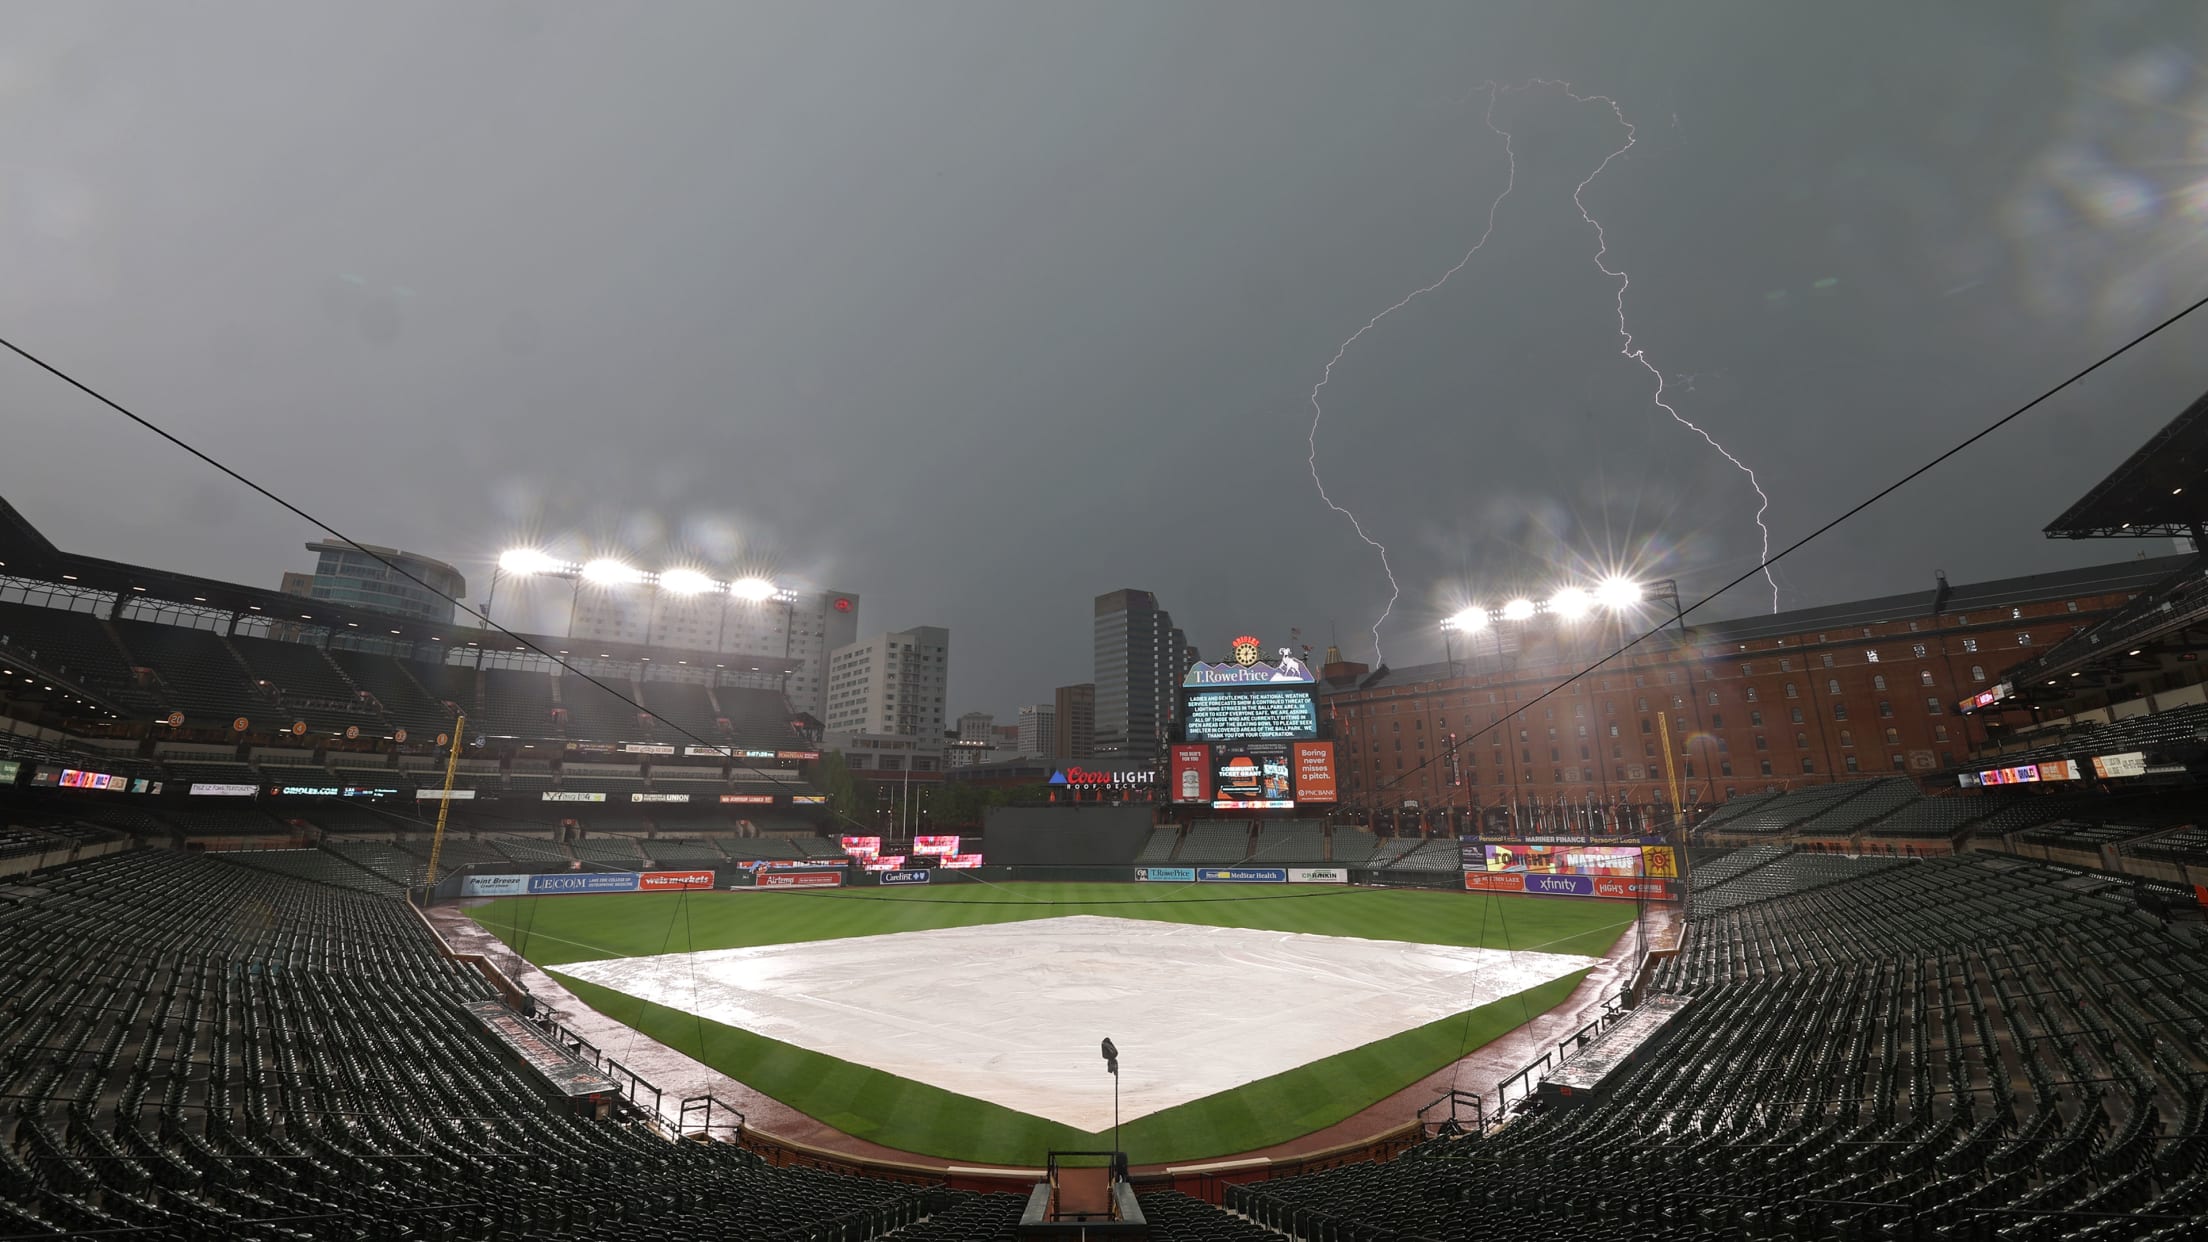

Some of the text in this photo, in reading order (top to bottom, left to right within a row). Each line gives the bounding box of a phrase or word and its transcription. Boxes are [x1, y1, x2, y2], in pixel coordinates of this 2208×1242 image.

[1301, 749, 1327, 758] Boring
[1302, 764, 1328, 772] misses
[1067, 766, 1155, 784] Coors LIGHT
[1309, 771, 1331, 781] pitch.
[646, 875, 709, 884] weis markets
[1230, 871, 1255, 879] MedStar
[1256, 871, 1277, 879] Health
[534, 878, 586, 889] LECOM
[1540, 876, 1577, 892] xfinity
[1599, 883, 1624, 895] HIGH'S
